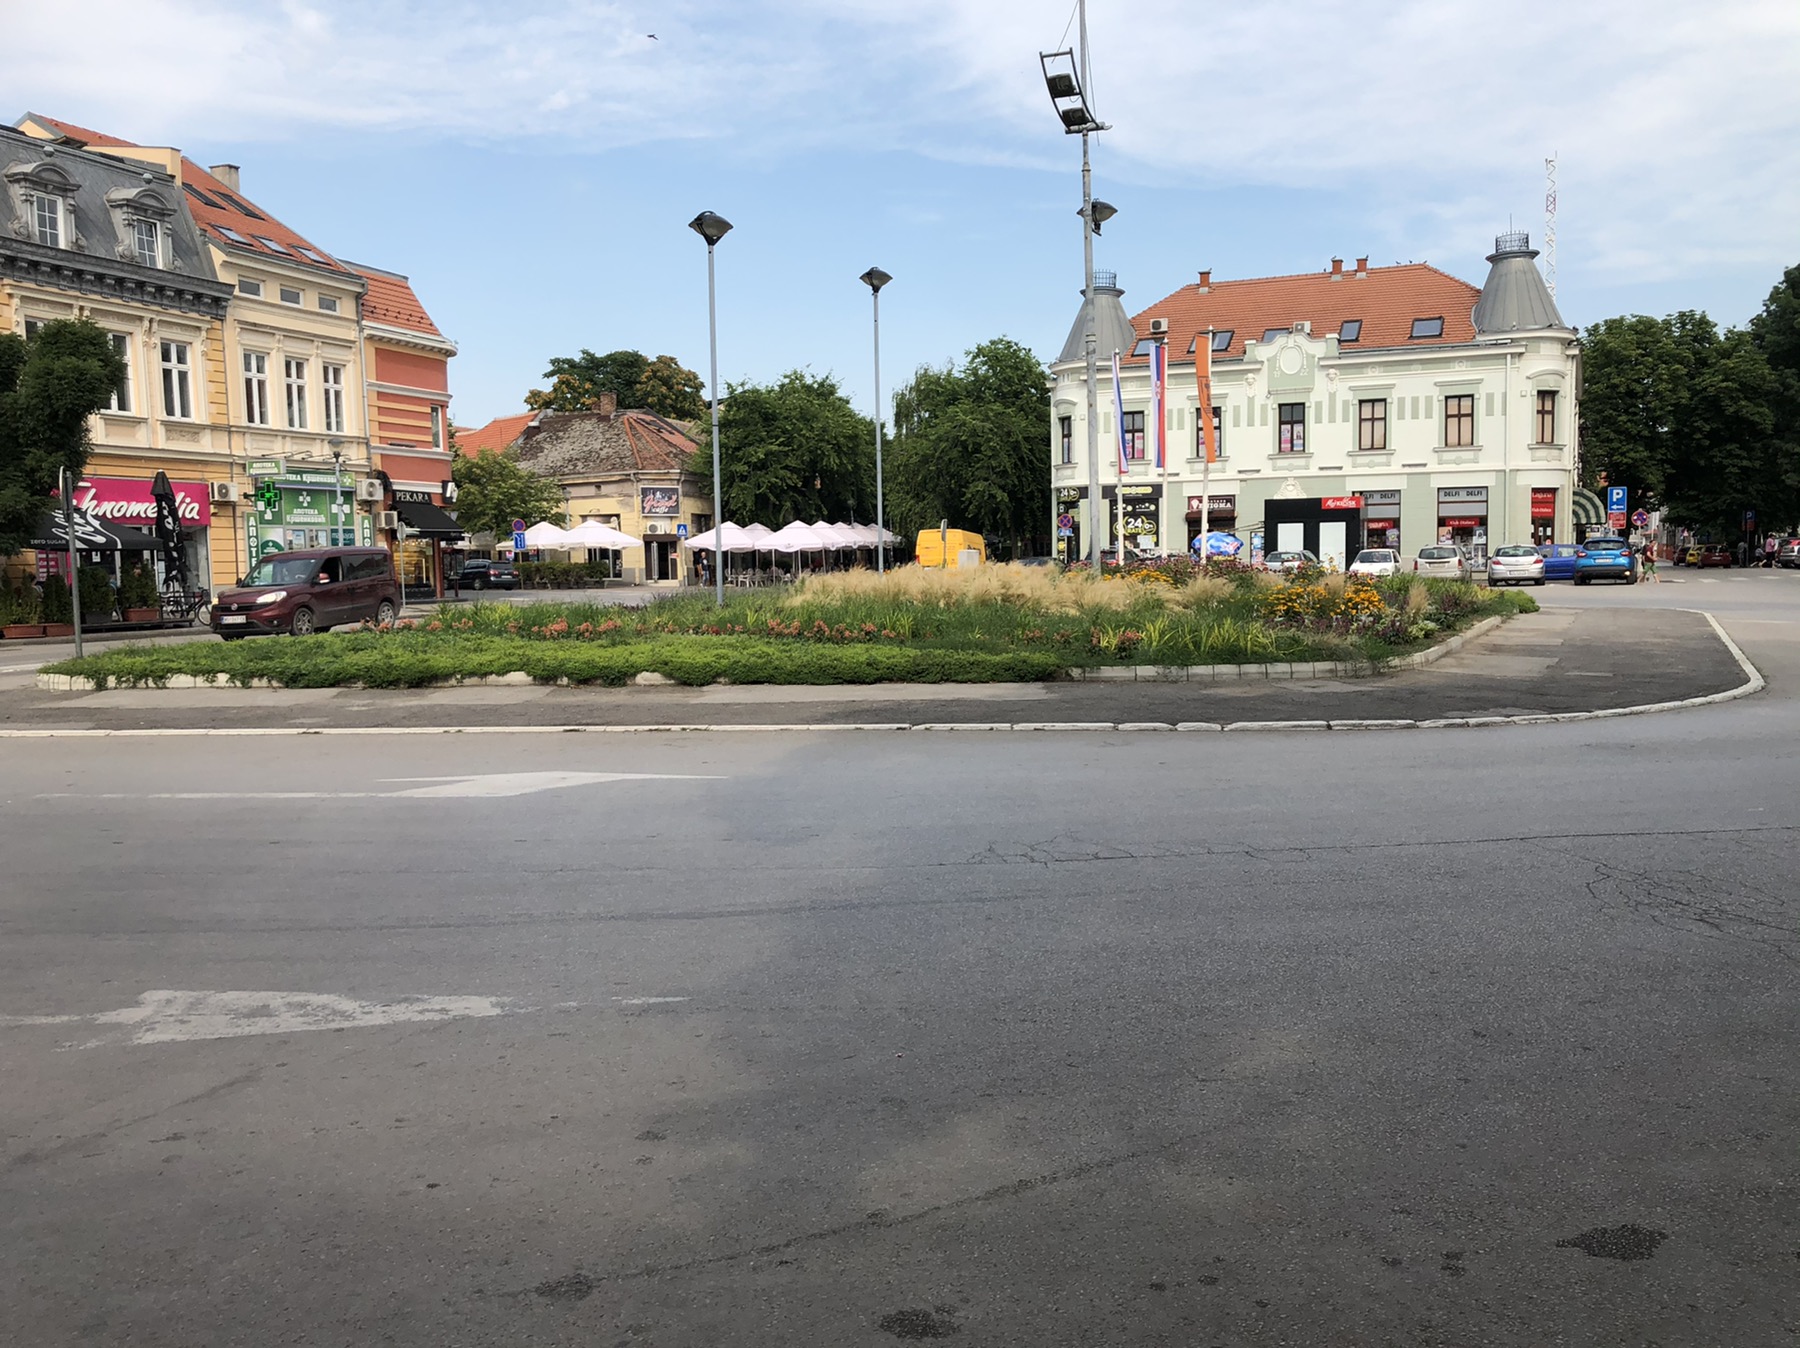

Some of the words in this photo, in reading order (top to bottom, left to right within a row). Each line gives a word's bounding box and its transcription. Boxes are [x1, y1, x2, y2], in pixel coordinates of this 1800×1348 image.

[396, 491, 430, 503] PEKARA
[1612, 489, 1624, 502] P
[1127, 518, 1143, 529] 24
